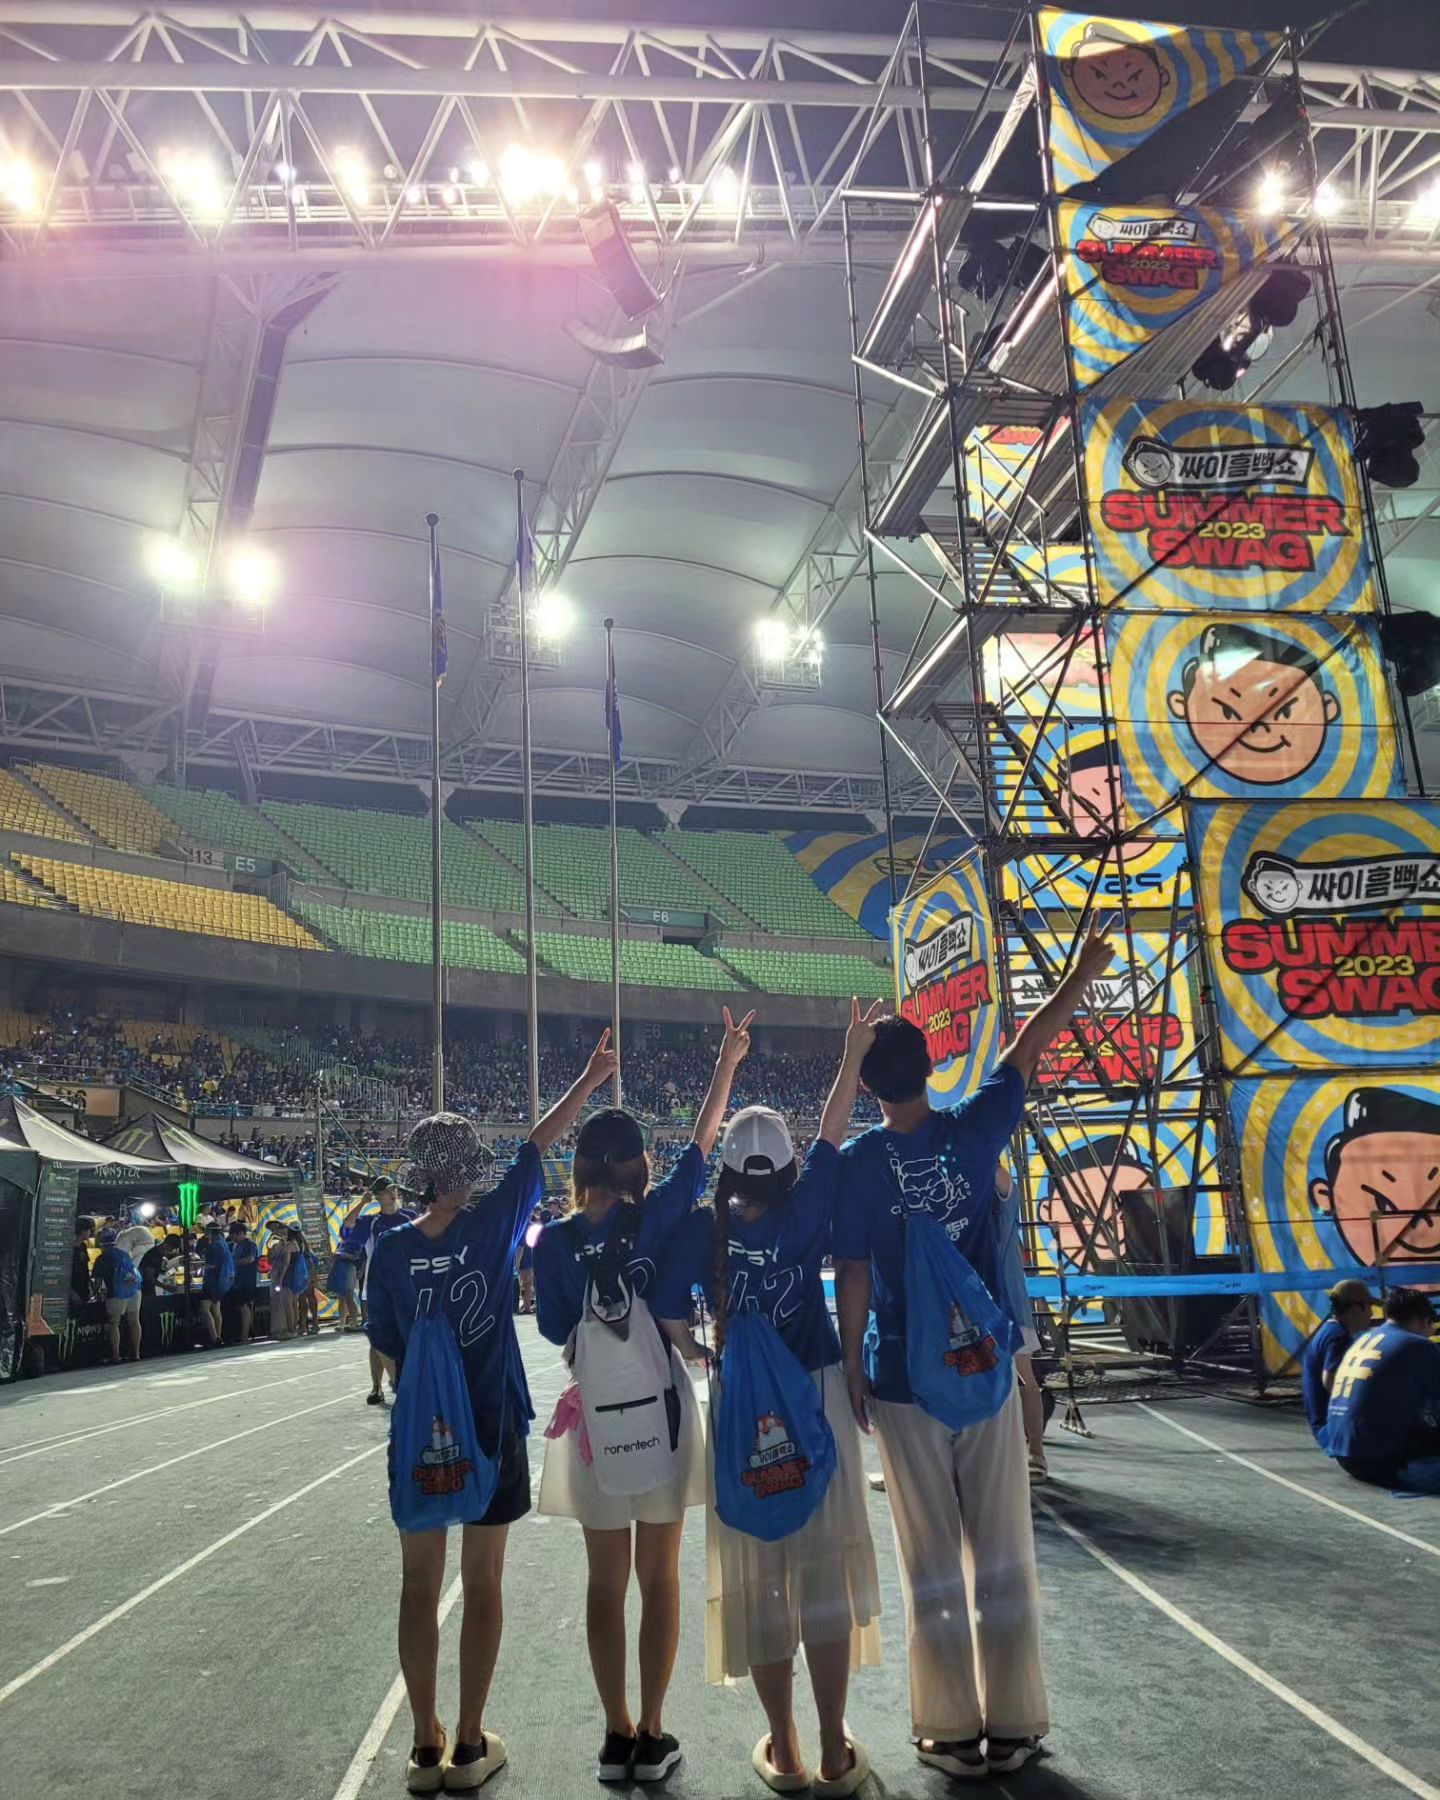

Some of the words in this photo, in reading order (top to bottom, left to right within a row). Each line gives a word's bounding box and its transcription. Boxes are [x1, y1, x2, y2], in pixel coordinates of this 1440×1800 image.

[1119, 222, 1189, 236] 싸이쇼
[1130, 258, 1171, 270] 2023
[1178, 451, 1298, 480] 싸이흠뻑쇼
[1101, 491, 1347, 535] SUMMER
[1197, 521, 1267, 541] 2023
[1149, 528, 1312, 568] SWAG
[235, 855, 256, 873] E5
[652, 910, 669, 923] E6
[918, 923, 967, 973] 싸이흠뻑쇼
[1334, 954, 1416, 977] 2023
[901, 964, 990, 1029] SUMMER
[928, 1007, 951, 1034] 2023
[923, 1013, 970, 1062] WAG
[409, 1245, 468, 1275] PSY
